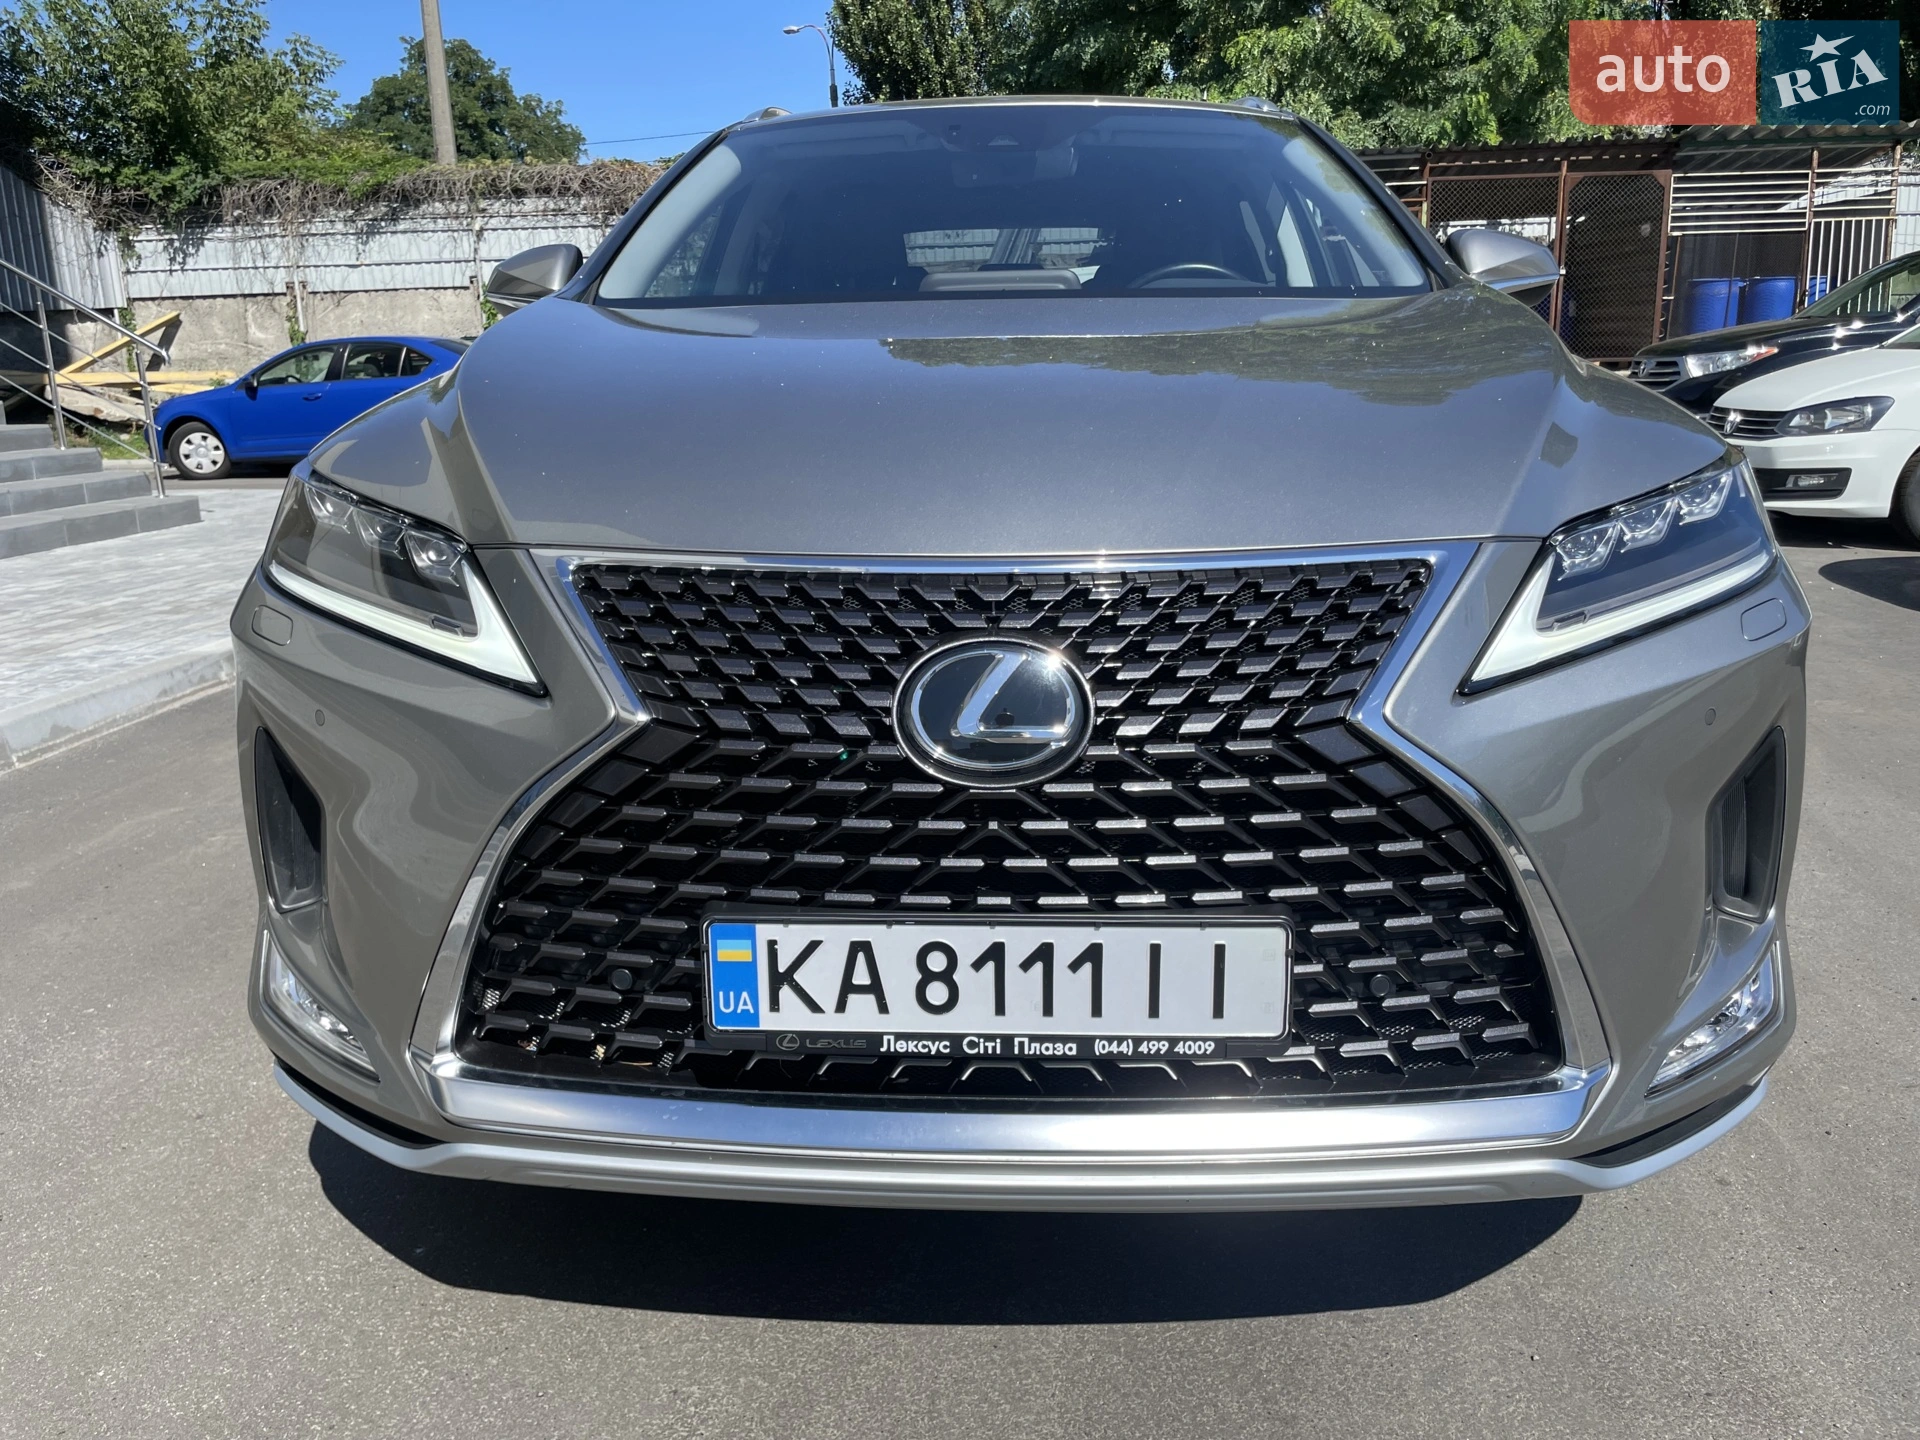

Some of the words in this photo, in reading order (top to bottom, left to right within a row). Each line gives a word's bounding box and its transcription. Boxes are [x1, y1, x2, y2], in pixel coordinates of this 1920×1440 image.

[766, 938, 890, 1015] KA
[914, 940, 1104, 1018] 8111
[718, 991, 755, 1014] UA
[805, 1039, 867, 1049] LEXUS
[879, 1035, 950, 1055] Лексус
[962, 1036, 1001, 1055] Сіті
[1013, 1037, 1077, 1056] Плаза
[1094, 1038, 1133, 1056] (044)
[1137, 1040, 1169, 1055] 499
[1173, 1040, 1215, 1055] 4009
